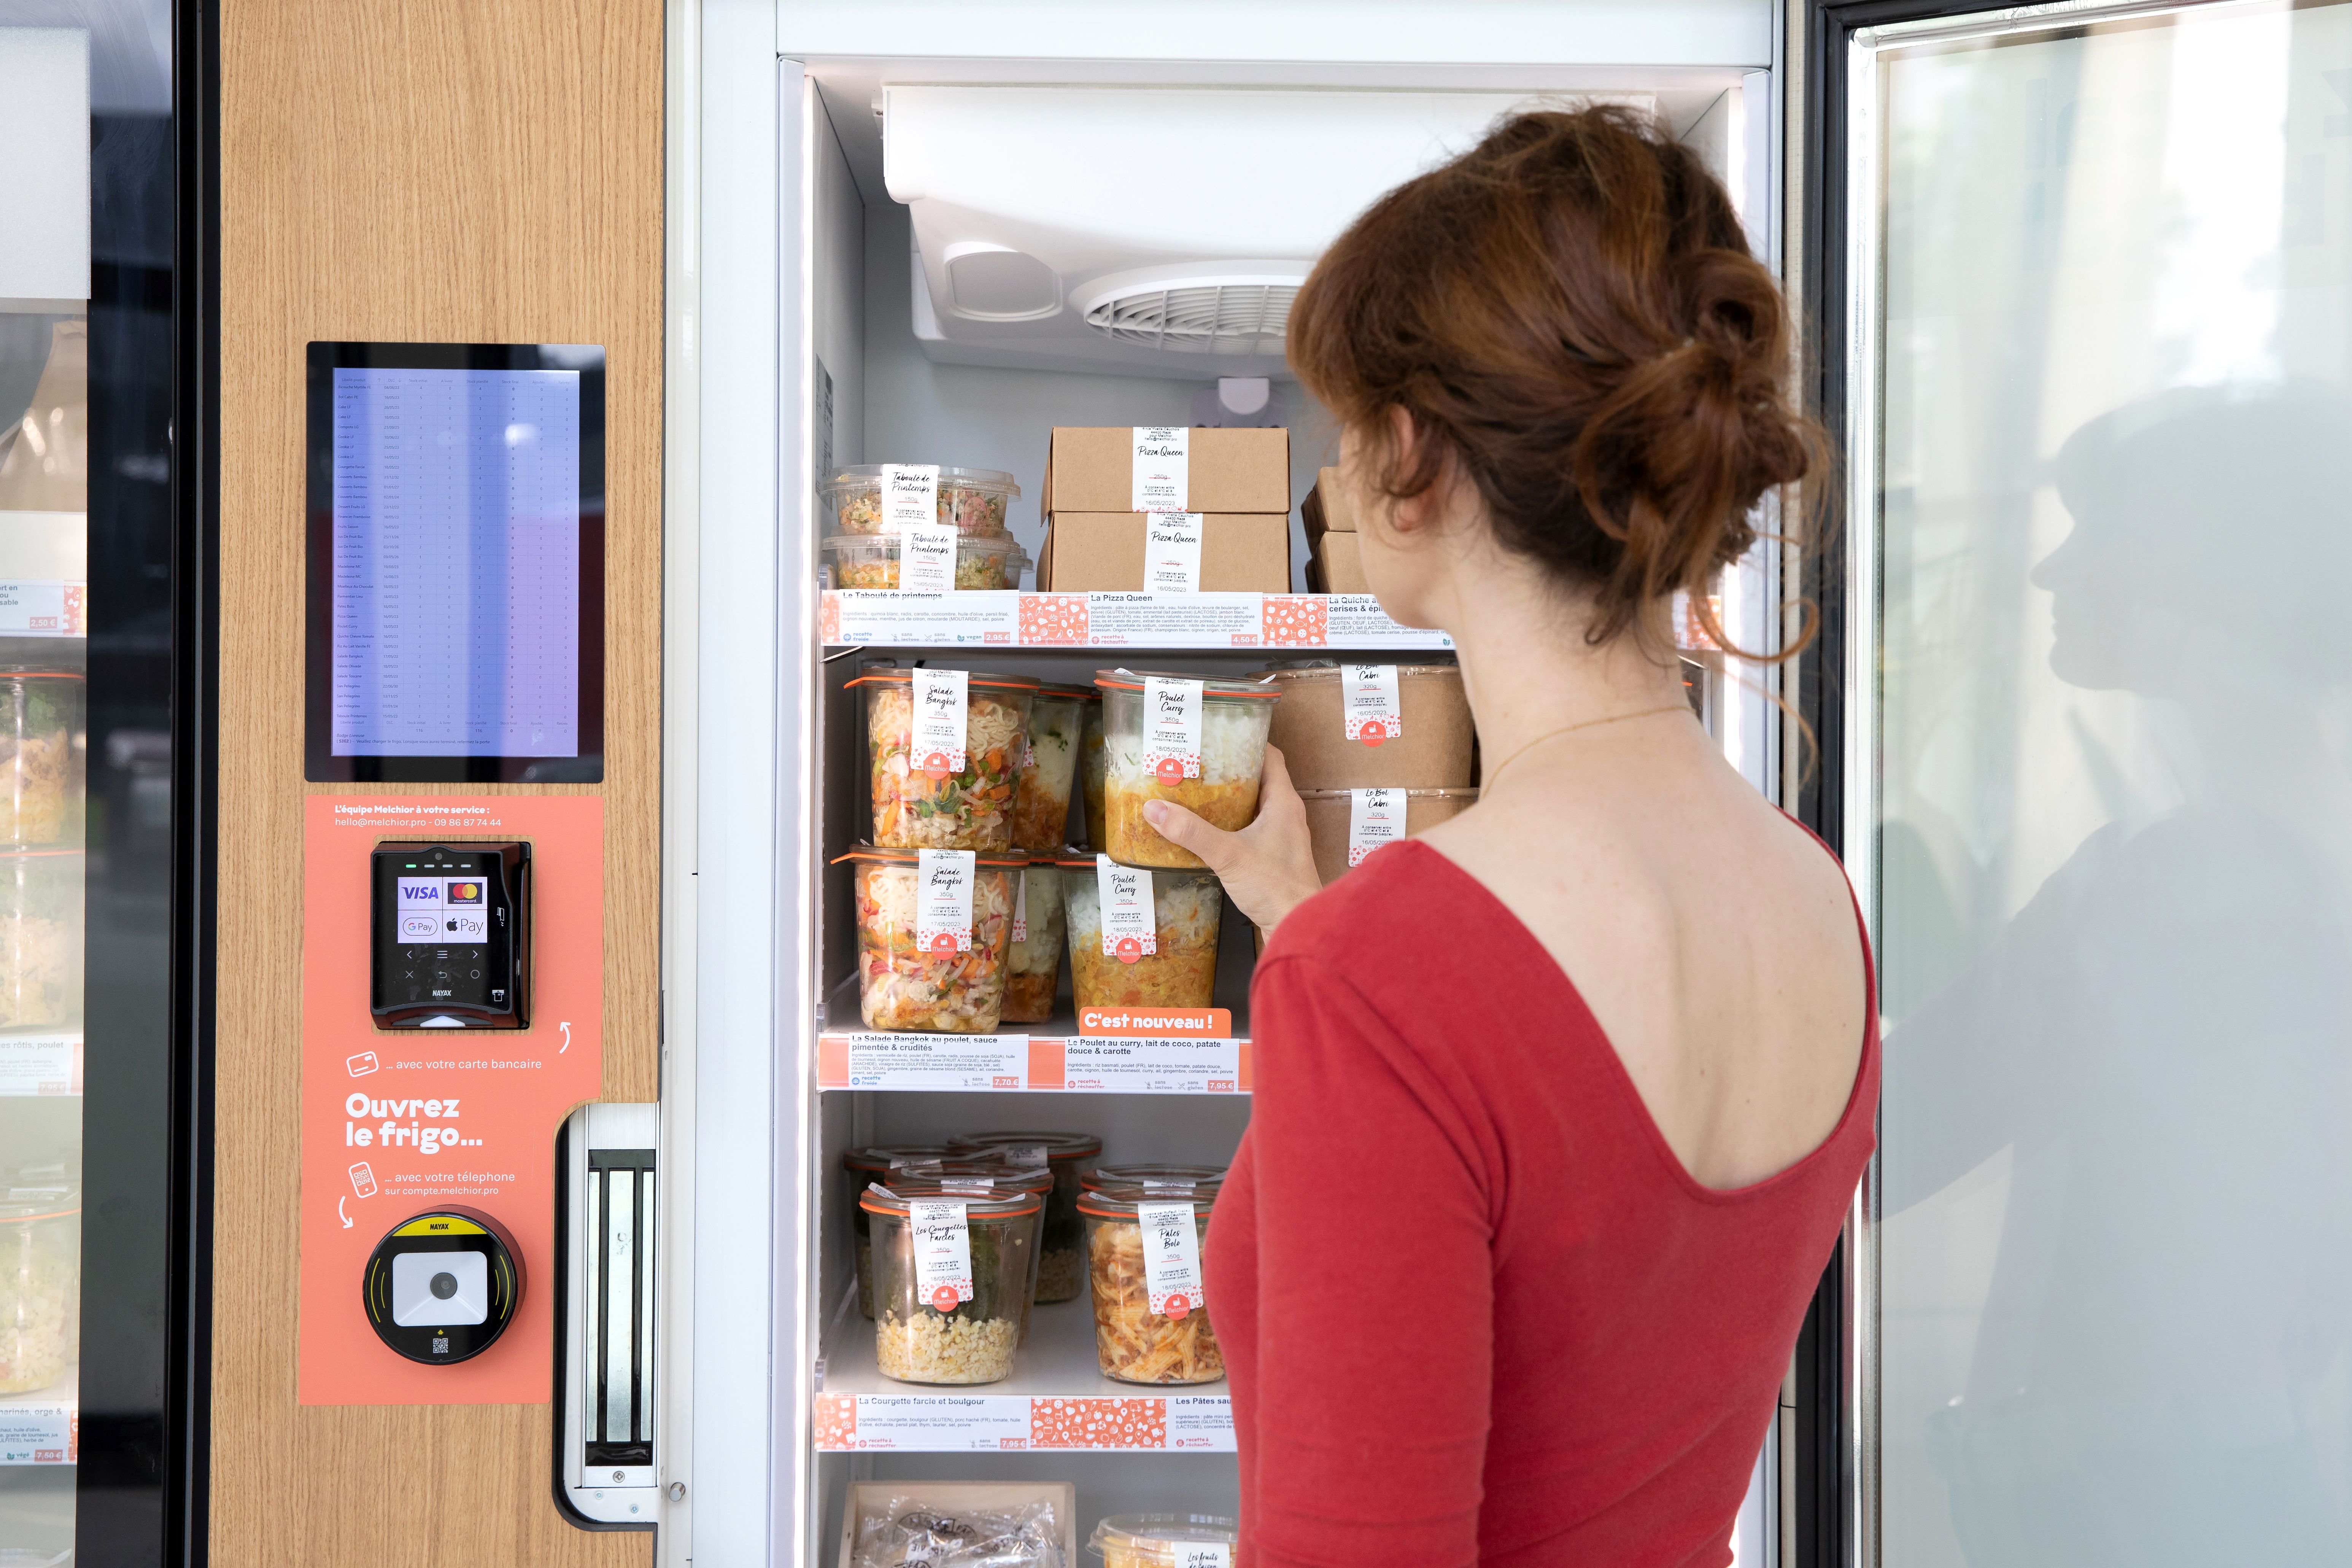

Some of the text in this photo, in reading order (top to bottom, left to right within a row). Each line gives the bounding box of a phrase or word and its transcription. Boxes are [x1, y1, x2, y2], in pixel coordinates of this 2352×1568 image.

[1138, 446, 1184, 457] Pizza Queen
[893, 472, 920, 481] Taboulé
[892, 481, 931, 494] Printemps
[912, 533, 939, 543] Taboulé
[910, 543, 949, 555] Printemps
[926, 685, 954, 696] Salade
[925, 694, 957, 709] Bangkok
[1159, 691, 1185, 702] Poulet
[1161, 702, 1184, 715] Curry
[1368, 798, 1389, 808] Cabri
[335, 805, 372, 815] L'équipe
[335, 818, 426, 828] hello@melchior.pro
[401, 887, 439, 899] VISA
[418, 923, 432, 933] Pay
[461, 919, 483, 935] Pay
[1085, 1013, 1130, 1028] C'est
[1133, 1017, 1203, 1029] nouveau
[426, 1060, 455, 1069] votre
[459, 1060, 487, 1069] carte
[492, 1059, 541, 1068] bancaire
[346, 1093, 460, 1118] Ouvrez
[346, 1121, 482, 1154] le frigo...
[425, 1173, 453, 1182] votre
[457, 1171, 515, 1184] télephone
[403, 1187, 498, 1196] compte.melchior.pro
[928, 1224, 968, 1235] Courgettes
[1159, 1228, 1181, 1239] Pâtes
[930, 1234, 955, 1242] Farcies
[1164, 1238, 1180, 1249] Bolo
[1188, 1552, 1218, 1566] Les fruits
